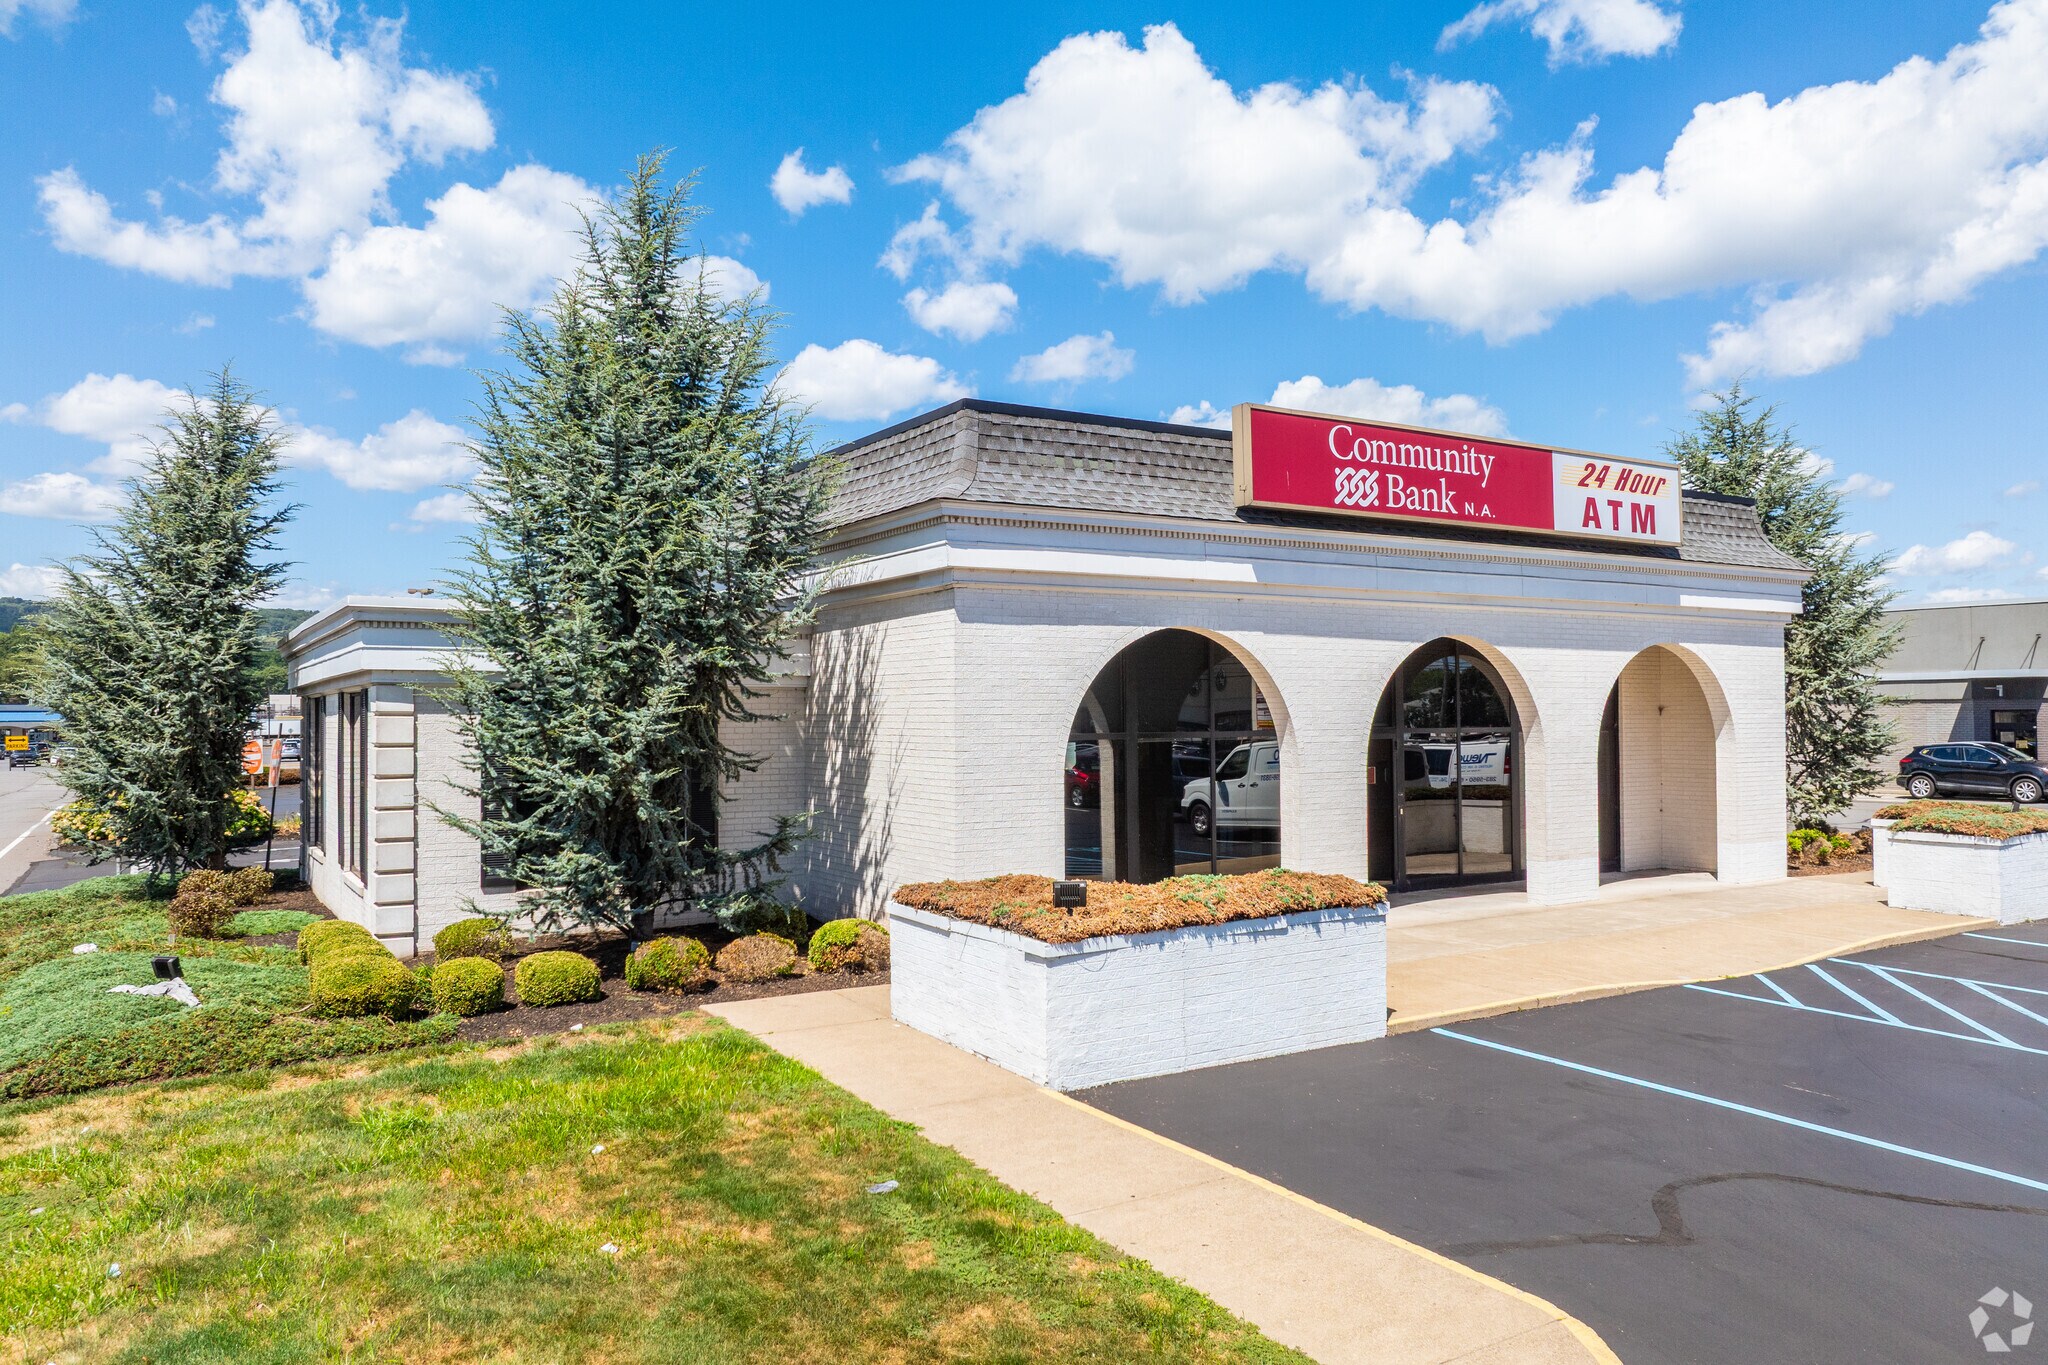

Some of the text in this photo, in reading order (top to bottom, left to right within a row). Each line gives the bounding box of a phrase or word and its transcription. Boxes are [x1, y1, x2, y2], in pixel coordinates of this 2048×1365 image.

[1328, 425, 1495, 488] Community
[1386, 473, 1496, 518] Bank N.A.
[1577, 463, 1666, 496] 24 Hour
[1582, 496, 1656, 535] ATM
